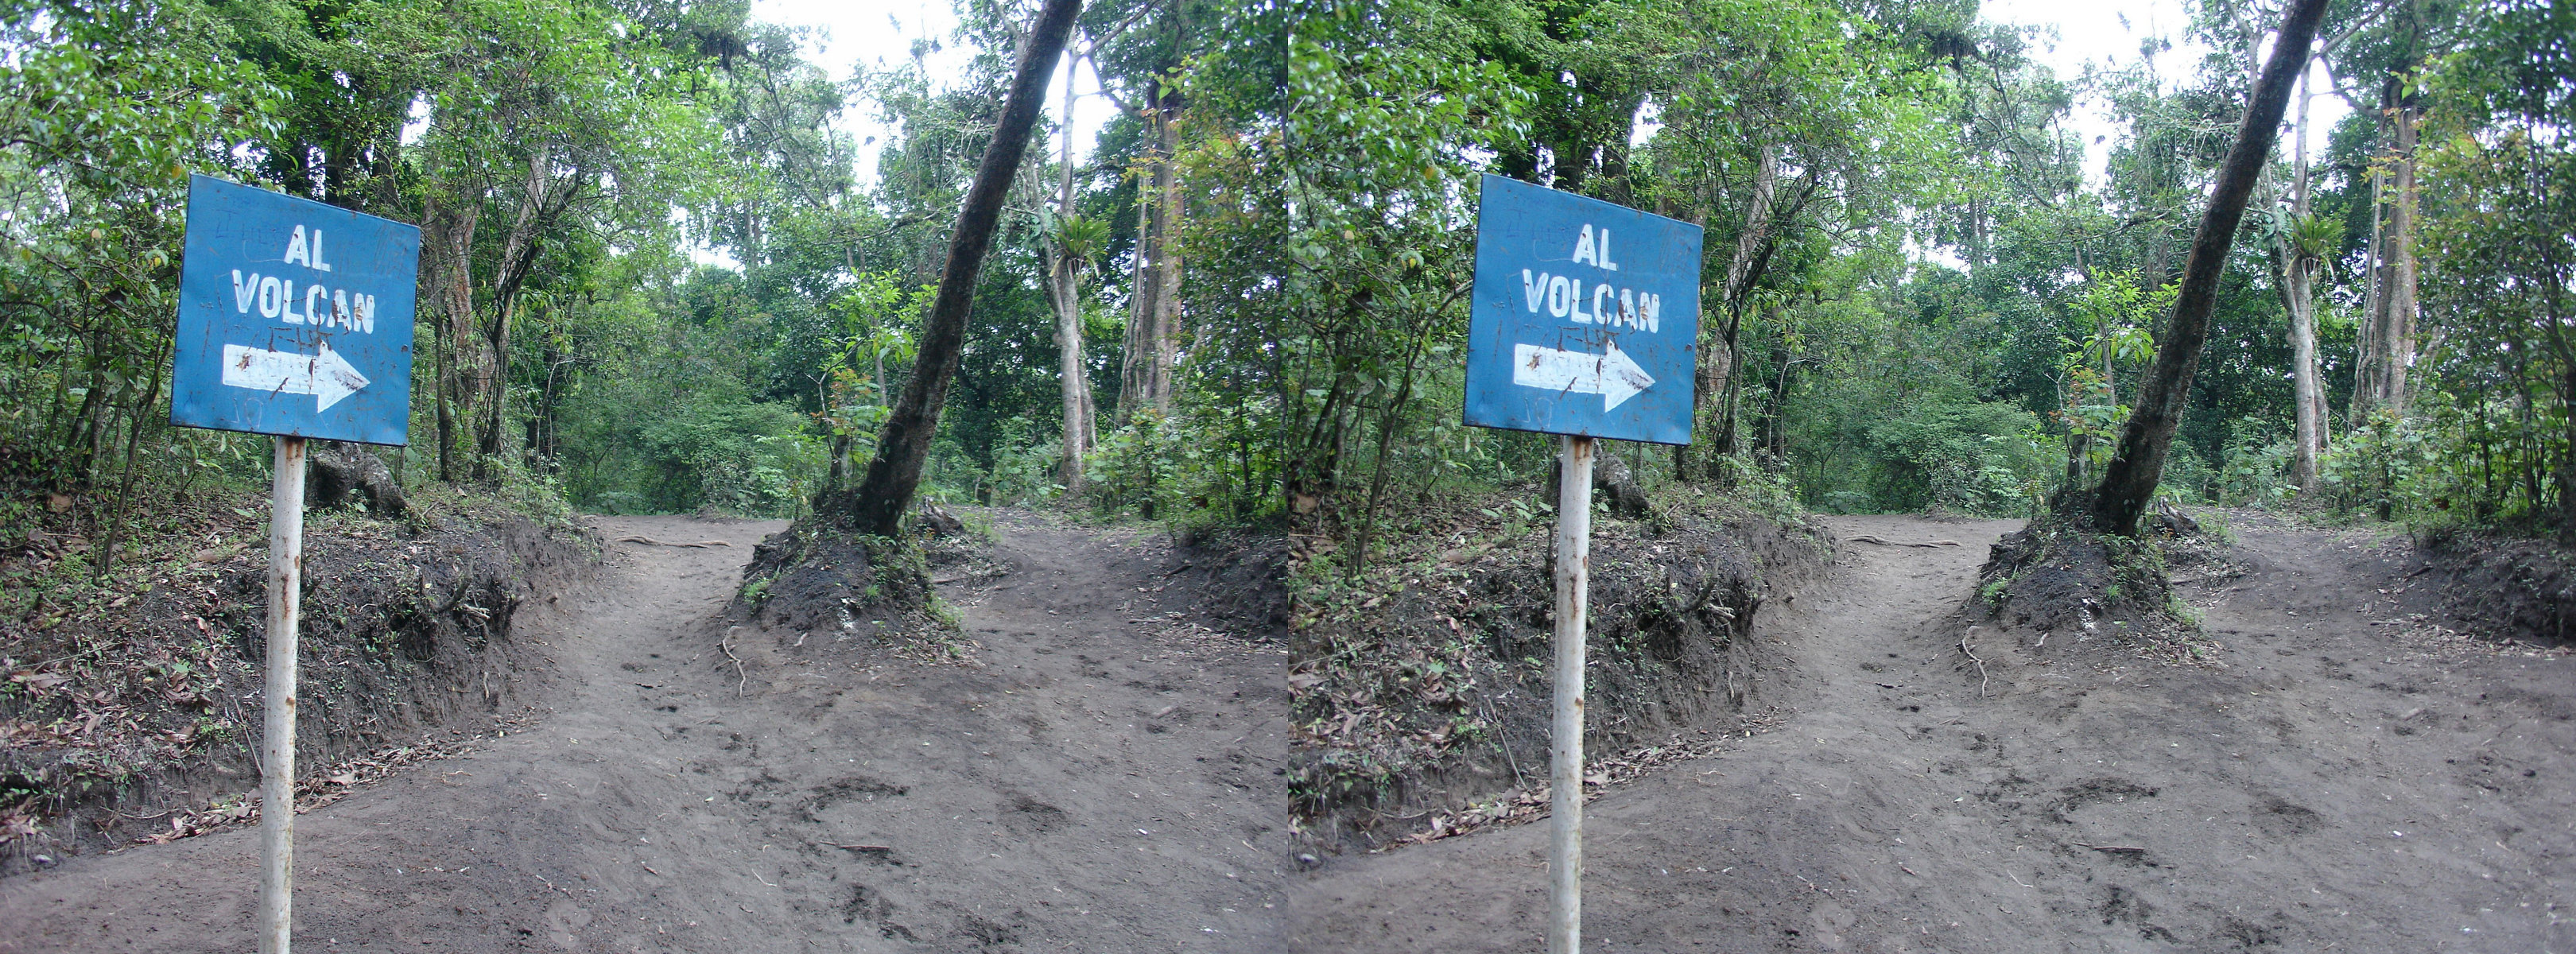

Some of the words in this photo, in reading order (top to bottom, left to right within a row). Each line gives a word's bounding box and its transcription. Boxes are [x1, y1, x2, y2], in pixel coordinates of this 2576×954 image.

[285, 225, 331, 272] AL
[1573, 224, 1617, 271] AL
[232, 270, 375, 334] VOLCAN
[1523, 269, 1660, 333] VOLCAN
